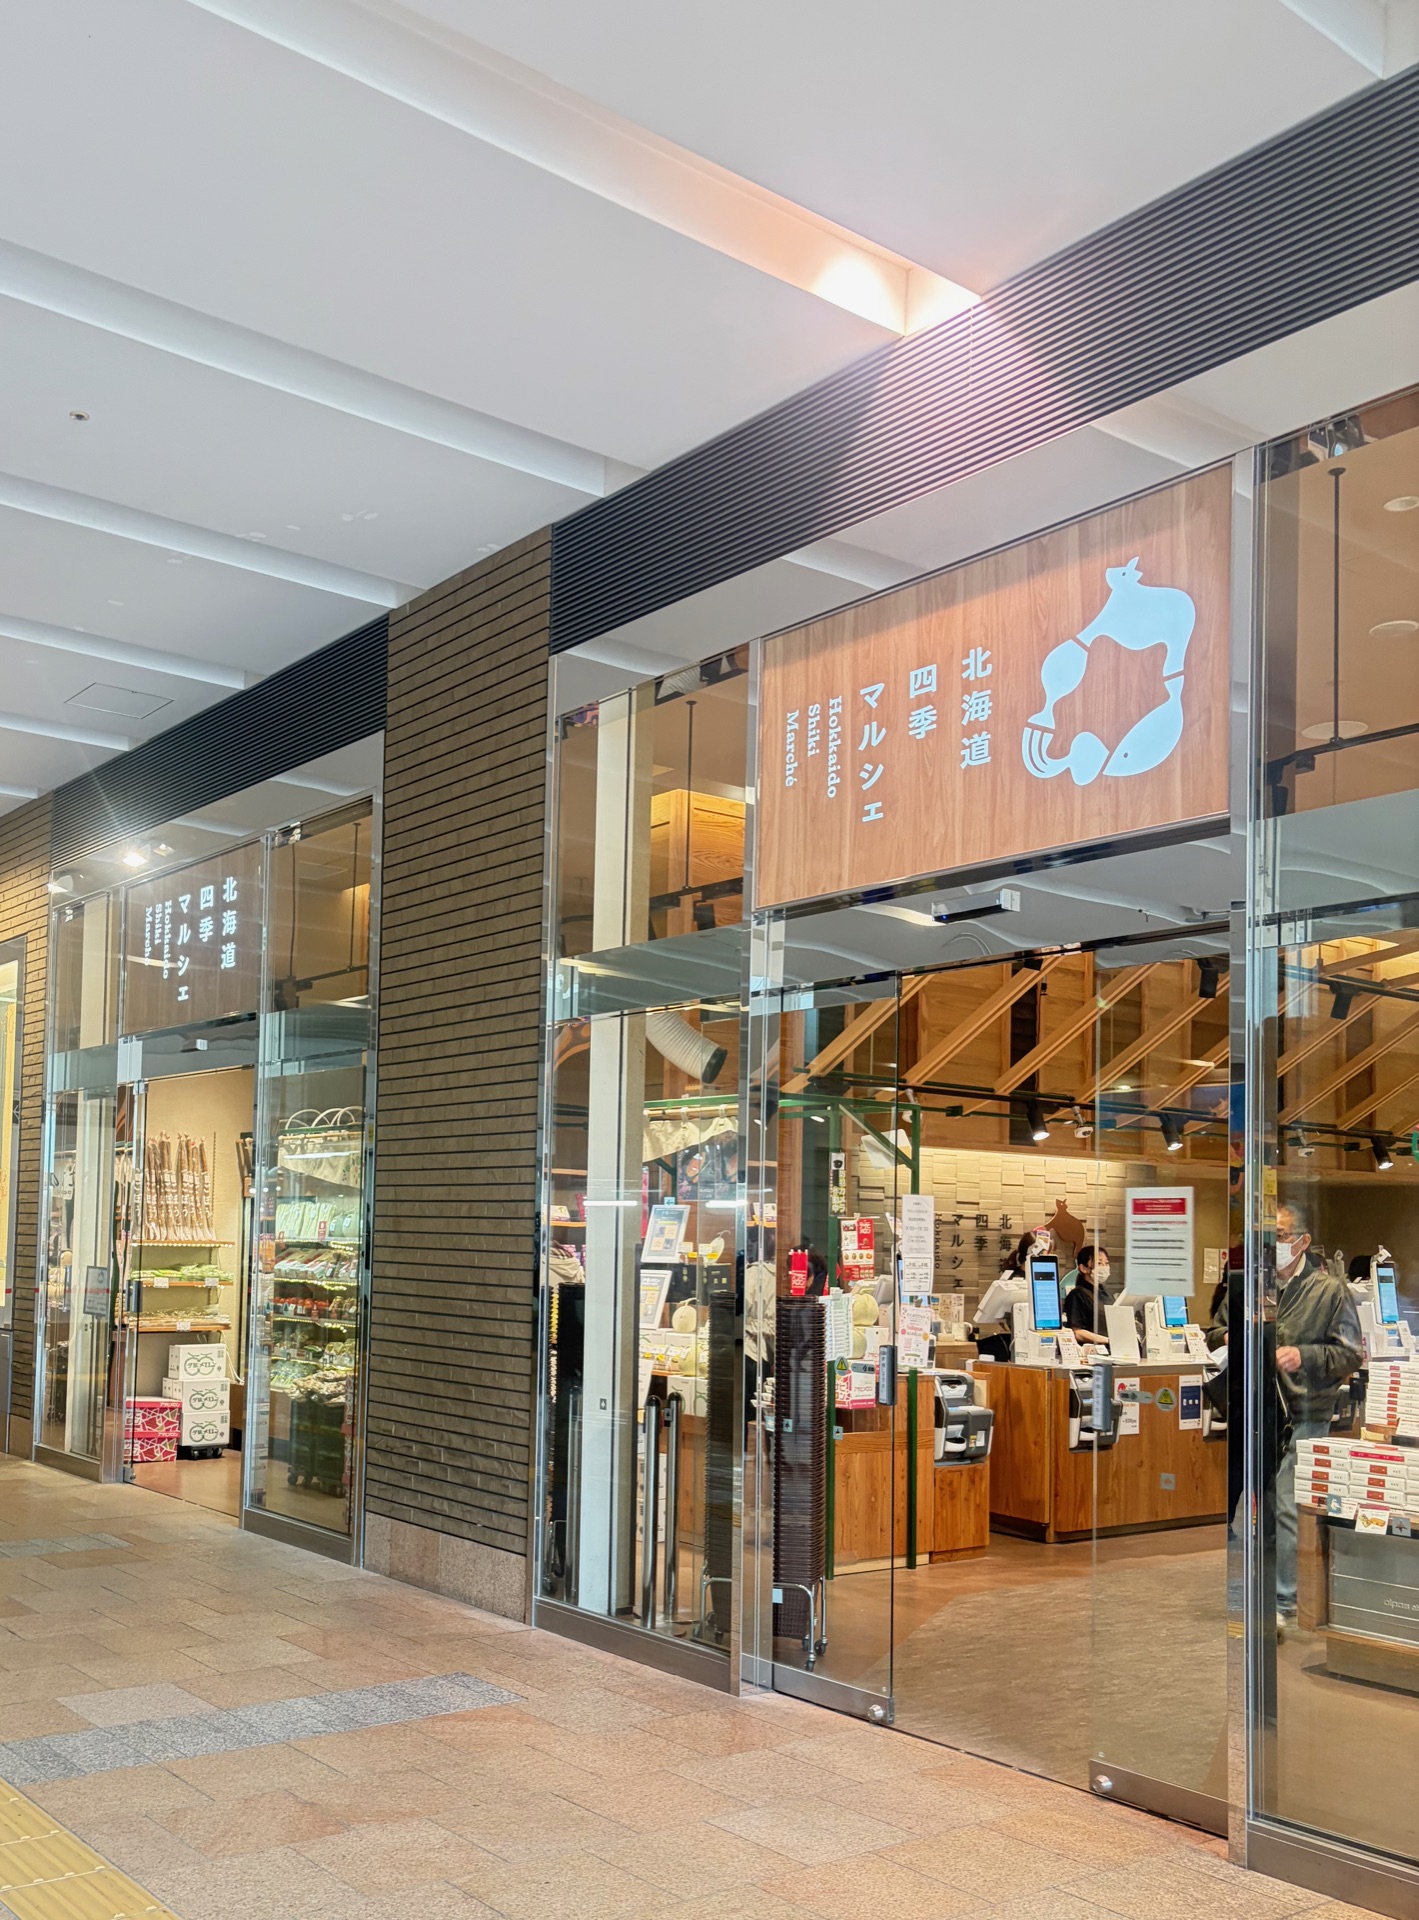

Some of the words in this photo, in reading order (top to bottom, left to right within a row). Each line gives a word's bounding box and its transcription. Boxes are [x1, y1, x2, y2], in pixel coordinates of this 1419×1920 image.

[807, 704, 821, 757] Shiki
[908, 663, 938, 740] 四季
[960, 647, 993, 770] 北海道
[786, 711, 800, 788] Marché
[827, 696, 842, 799] Hokkaido
[858, 682, 886, 823] マルシェ
[154, 903, 162, 945] Shiki
[162, 900, 172, 980] Hokkaido
[177, 894, 191, 1002] マルシェ
[199, 885, 214, 943] 四季
[220, 876, 238, 970] 北海道
[950, 1213, 965, 1288] マルシェ
[974, 1213, 988, 1251] 四季
